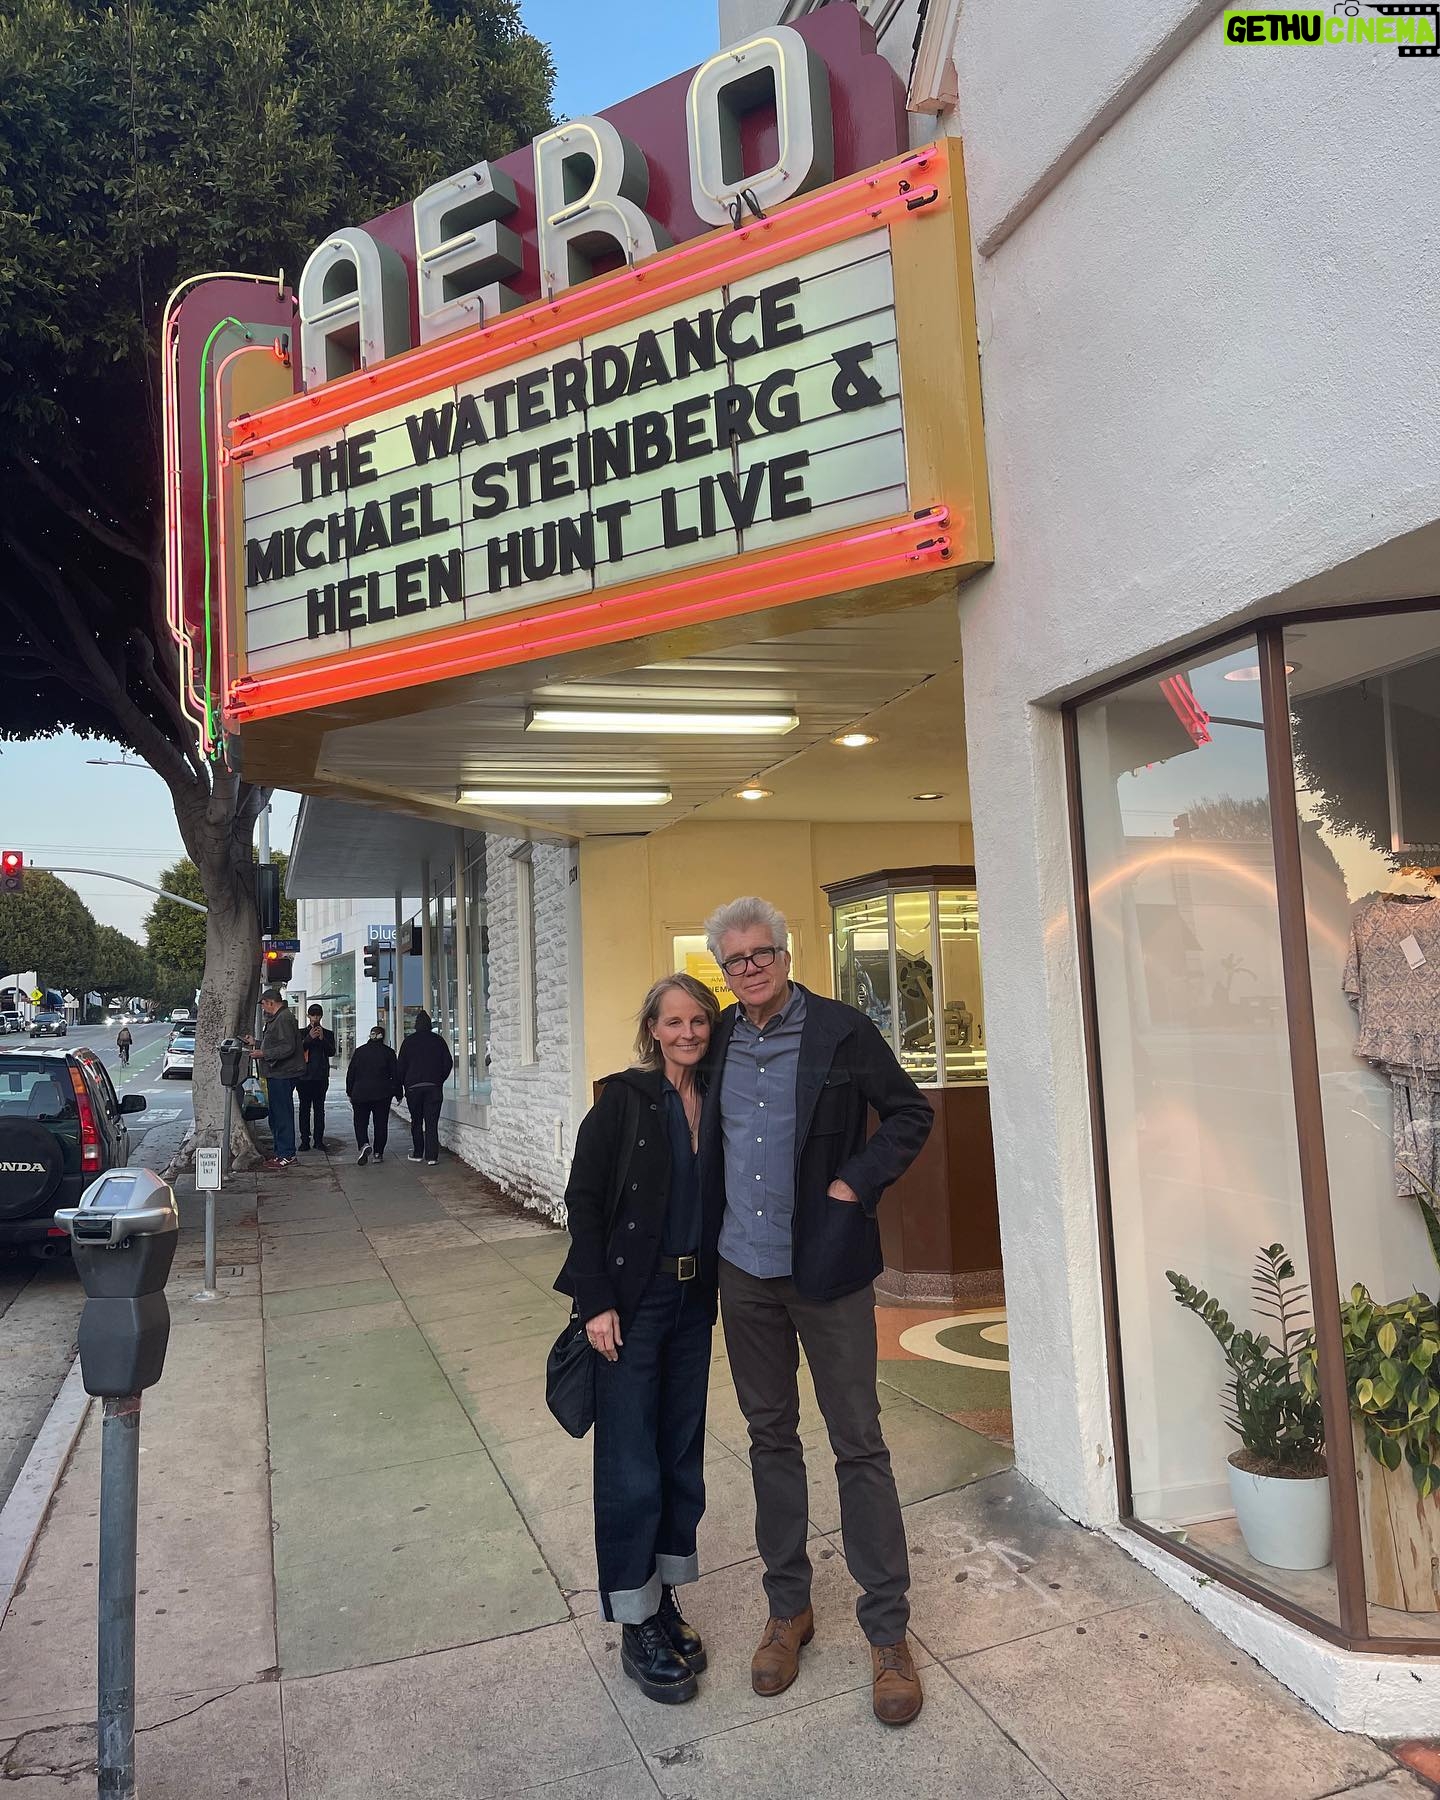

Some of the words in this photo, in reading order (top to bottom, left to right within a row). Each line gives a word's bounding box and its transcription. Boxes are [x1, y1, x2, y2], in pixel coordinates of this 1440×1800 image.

[300, 25, 832, 390] AERO
[247, 483, 449, 587] MICHAEL
[472, 368, 800, 521] STEINBERG
[831, 341, 886, 414] &
[293, 429, 377, 504] THE
[405, 277, 803, 466] WATERDANCE
[307, 548, 464, 639] HELEN
[487, 500, 631, 594] HUNT
[661, 449, 811, 549] LIVE
